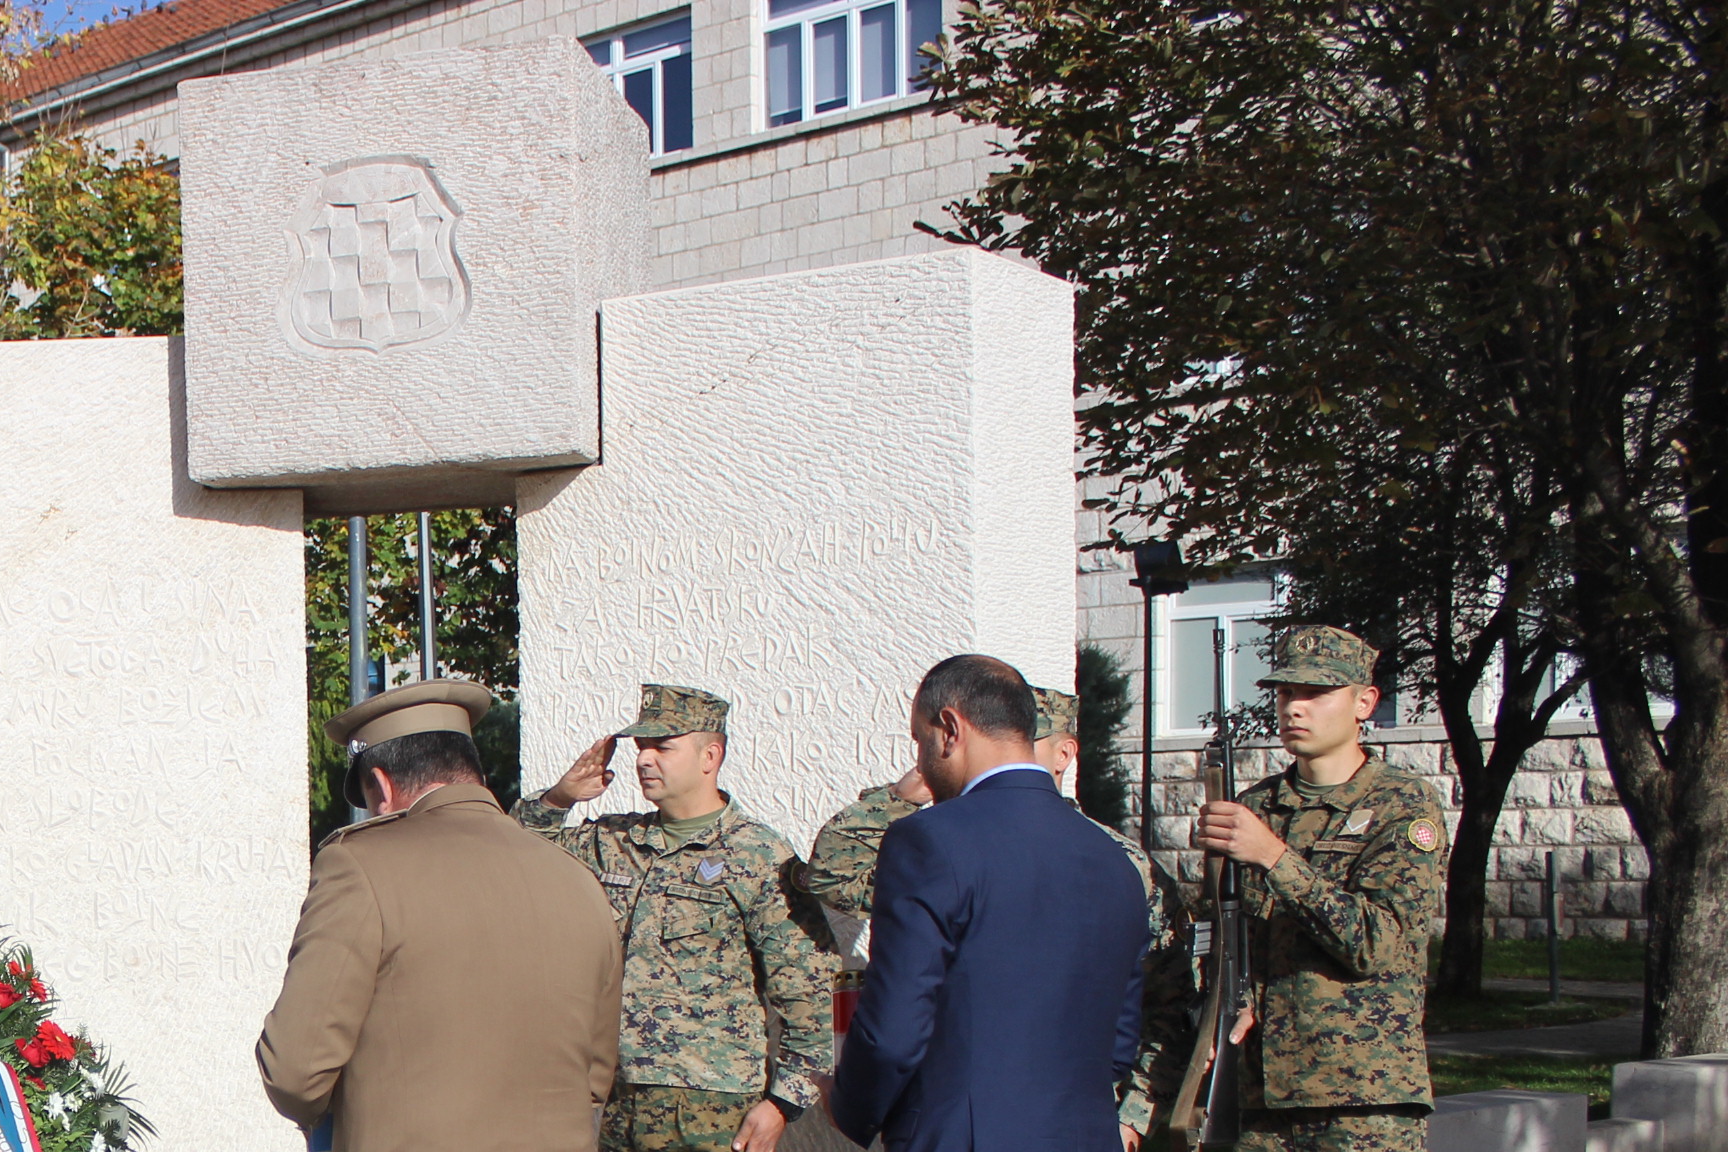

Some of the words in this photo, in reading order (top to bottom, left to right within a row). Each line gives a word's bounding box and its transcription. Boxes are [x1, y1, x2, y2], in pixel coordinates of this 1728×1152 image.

[547, 549, 582, 583] NA
[555, 597, 606, 633] ZA
[638, 582, 773, 630] HRVATSKU
[553, 635, 635, 681] TAKO
[651, 635, 688, 676] KO
[774, 677, 858, 720] OTAC
[752, 730, 827, 774] KAKO
